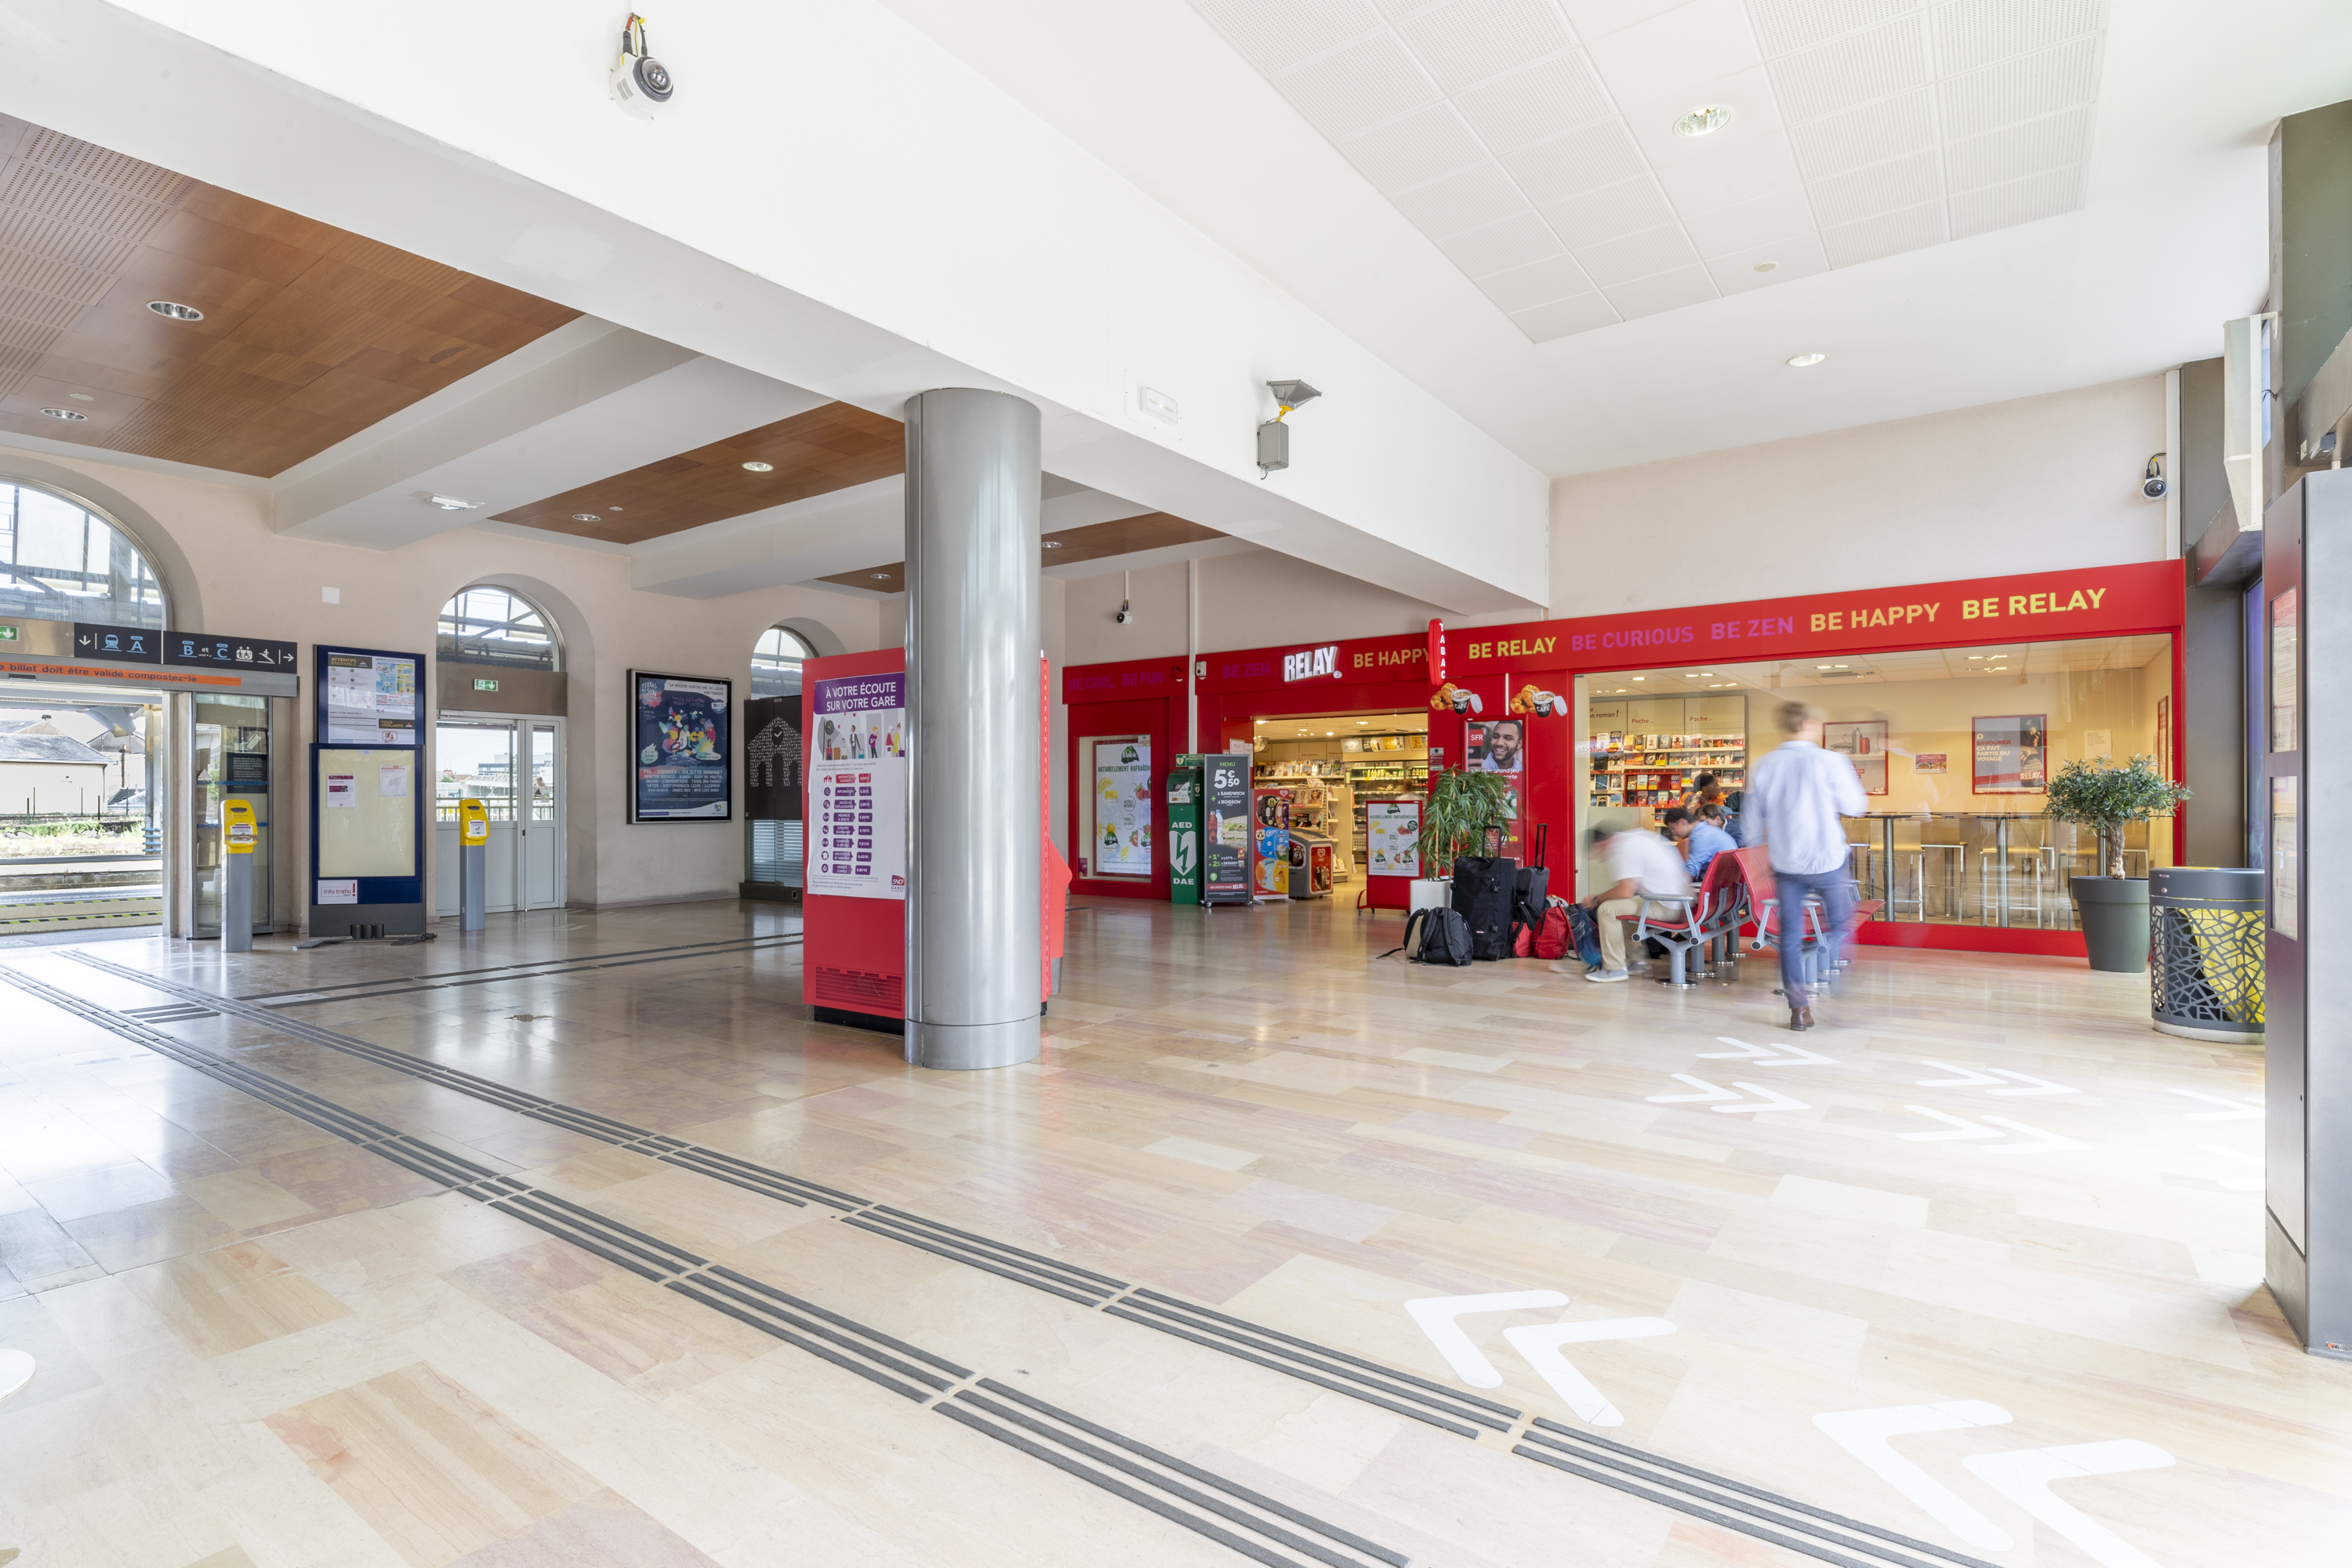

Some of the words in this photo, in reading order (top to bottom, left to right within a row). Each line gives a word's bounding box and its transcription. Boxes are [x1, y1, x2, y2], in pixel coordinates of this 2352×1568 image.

[1962, 598, 2002, 620] BE
[2008, 588, 2107, 617] RELAY
[1810, 612, 1845, 633] BE
[1850, 603, 1940, 629] HAPPY
[1711, 621, 1743, 641] BE
[1748, 616, 1794, 637] ZEN
[131, 641, 143, 652] A
[1571, 633, 1598, 652] BE
[1602, 626, 1693, 649] CURIOUS
[183, 645, 194, 655] B
[217, 648, 228, 659] C
[1468, 642, 1492, 659] BE
[1497, 637, 1557, 657] RELAY
[1353, 652, 1374, 668] BE
[1378, 648, 1428, 666] HAPPY
[42, 666, 63, 674] doit
[94, 669, 123, 677] validé
[128, 671, 197, 683] compostez-le
[1122, 673, 1138, 687] BE
[1140, 671, 1163, 684] FUN
[1222, 665, 1240, 679] BE
[1243, 662, 1270, 677] ZEN
[826, 686, 831, 699] À
[833, 685, 858, 697] VOTRE
[860, 682, 896, 695] ÉCOUTE
[1069, 677, 1083, 691] BE
[1086, 676, 1114, 689] COOL
[826, 701, 840, 712] SUR
[841, 698, 869, 710] VOTRE
[871, 695, 896, 707] GARE
[1454, 702, 1467, 710] CAFÉ
[1536, 704, 1550, 713] CAFÉ
